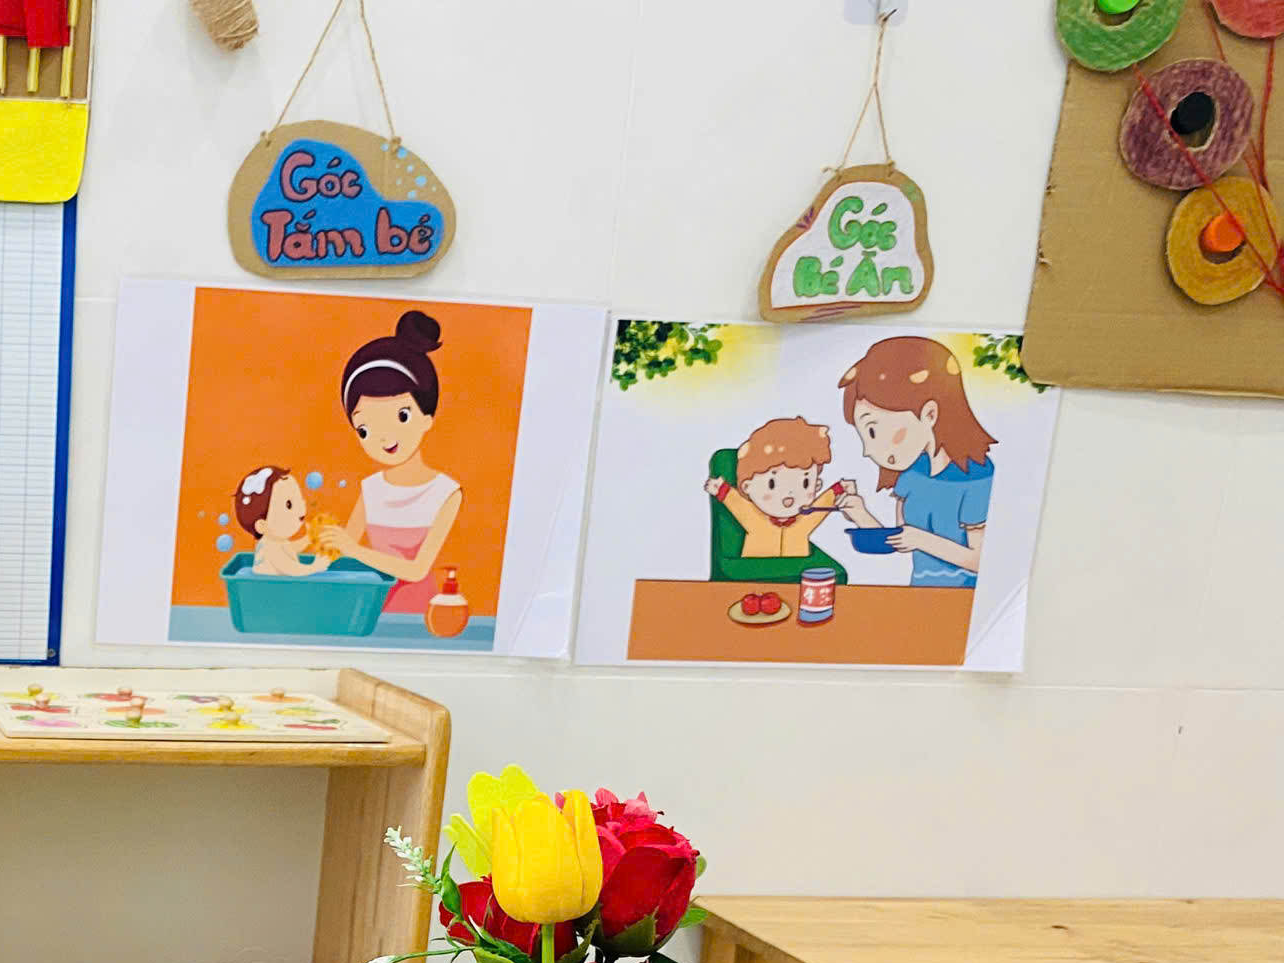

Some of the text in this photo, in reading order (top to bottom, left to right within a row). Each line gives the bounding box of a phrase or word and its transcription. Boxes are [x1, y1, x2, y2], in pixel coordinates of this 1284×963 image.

[280, 149, 363, 202] Góc
[260, 206, 435, 262] Tắm bé
[828, 196, 897, 251] Góc
[793, 256, 840, 297] Bé
